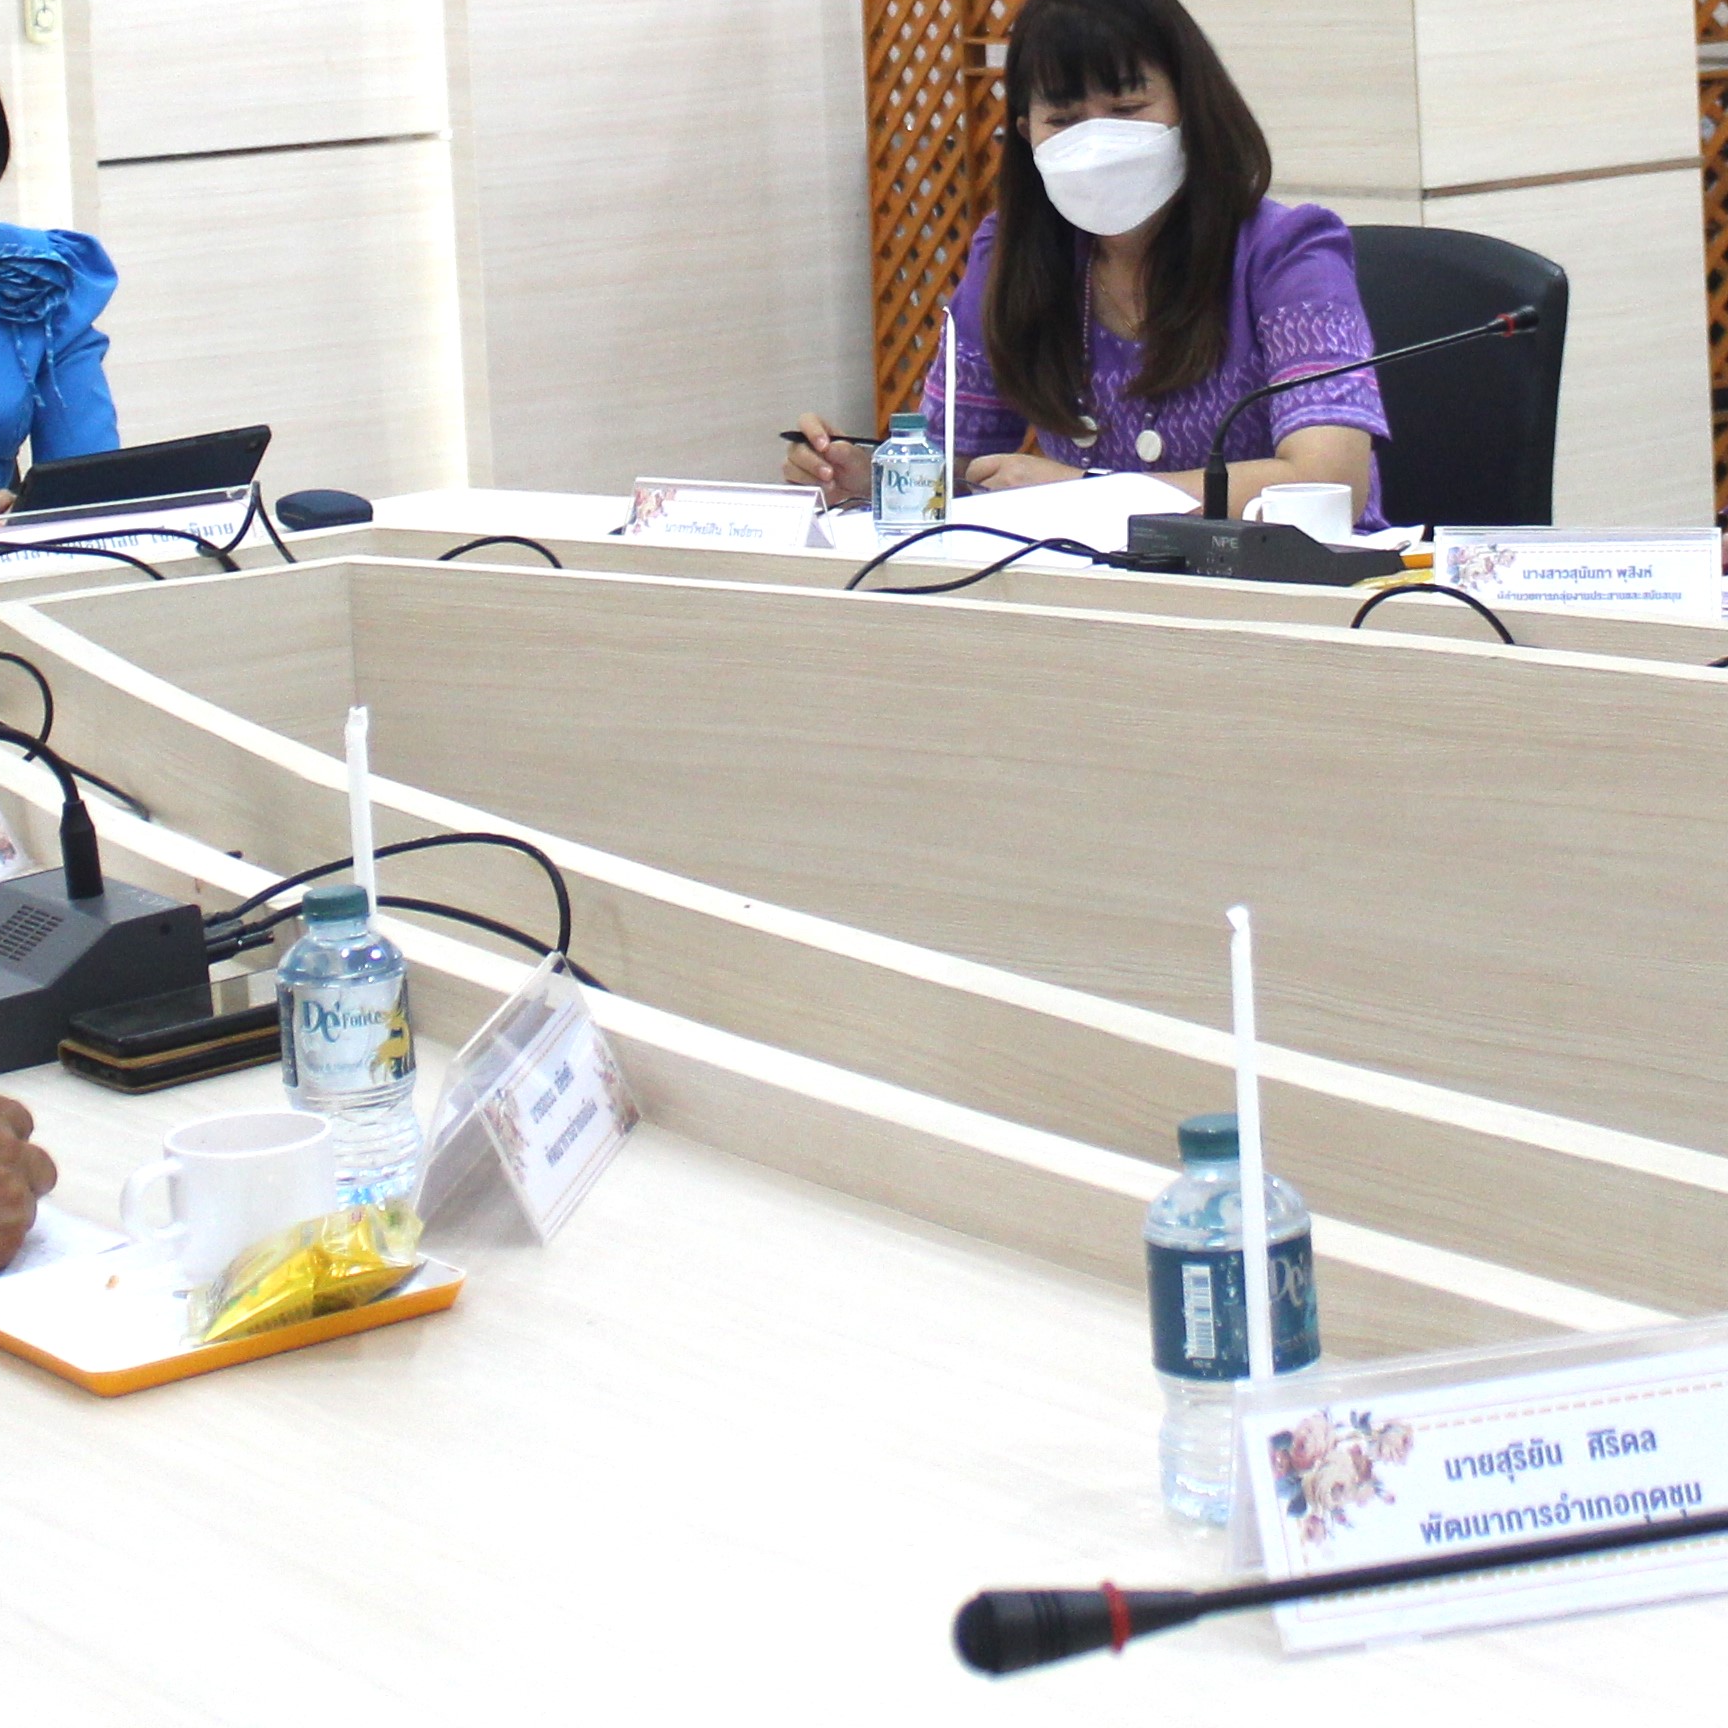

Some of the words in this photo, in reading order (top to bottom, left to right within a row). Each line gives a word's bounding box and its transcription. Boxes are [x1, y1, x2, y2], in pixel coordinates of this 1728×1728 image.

[1211, 535, 1240, 549] NPE
[1444, 1438, 1563, 1483] นายสุริยัน
[1419, 1479, 1703, 1545] พัฒนาการอำเภอกุดชุม
